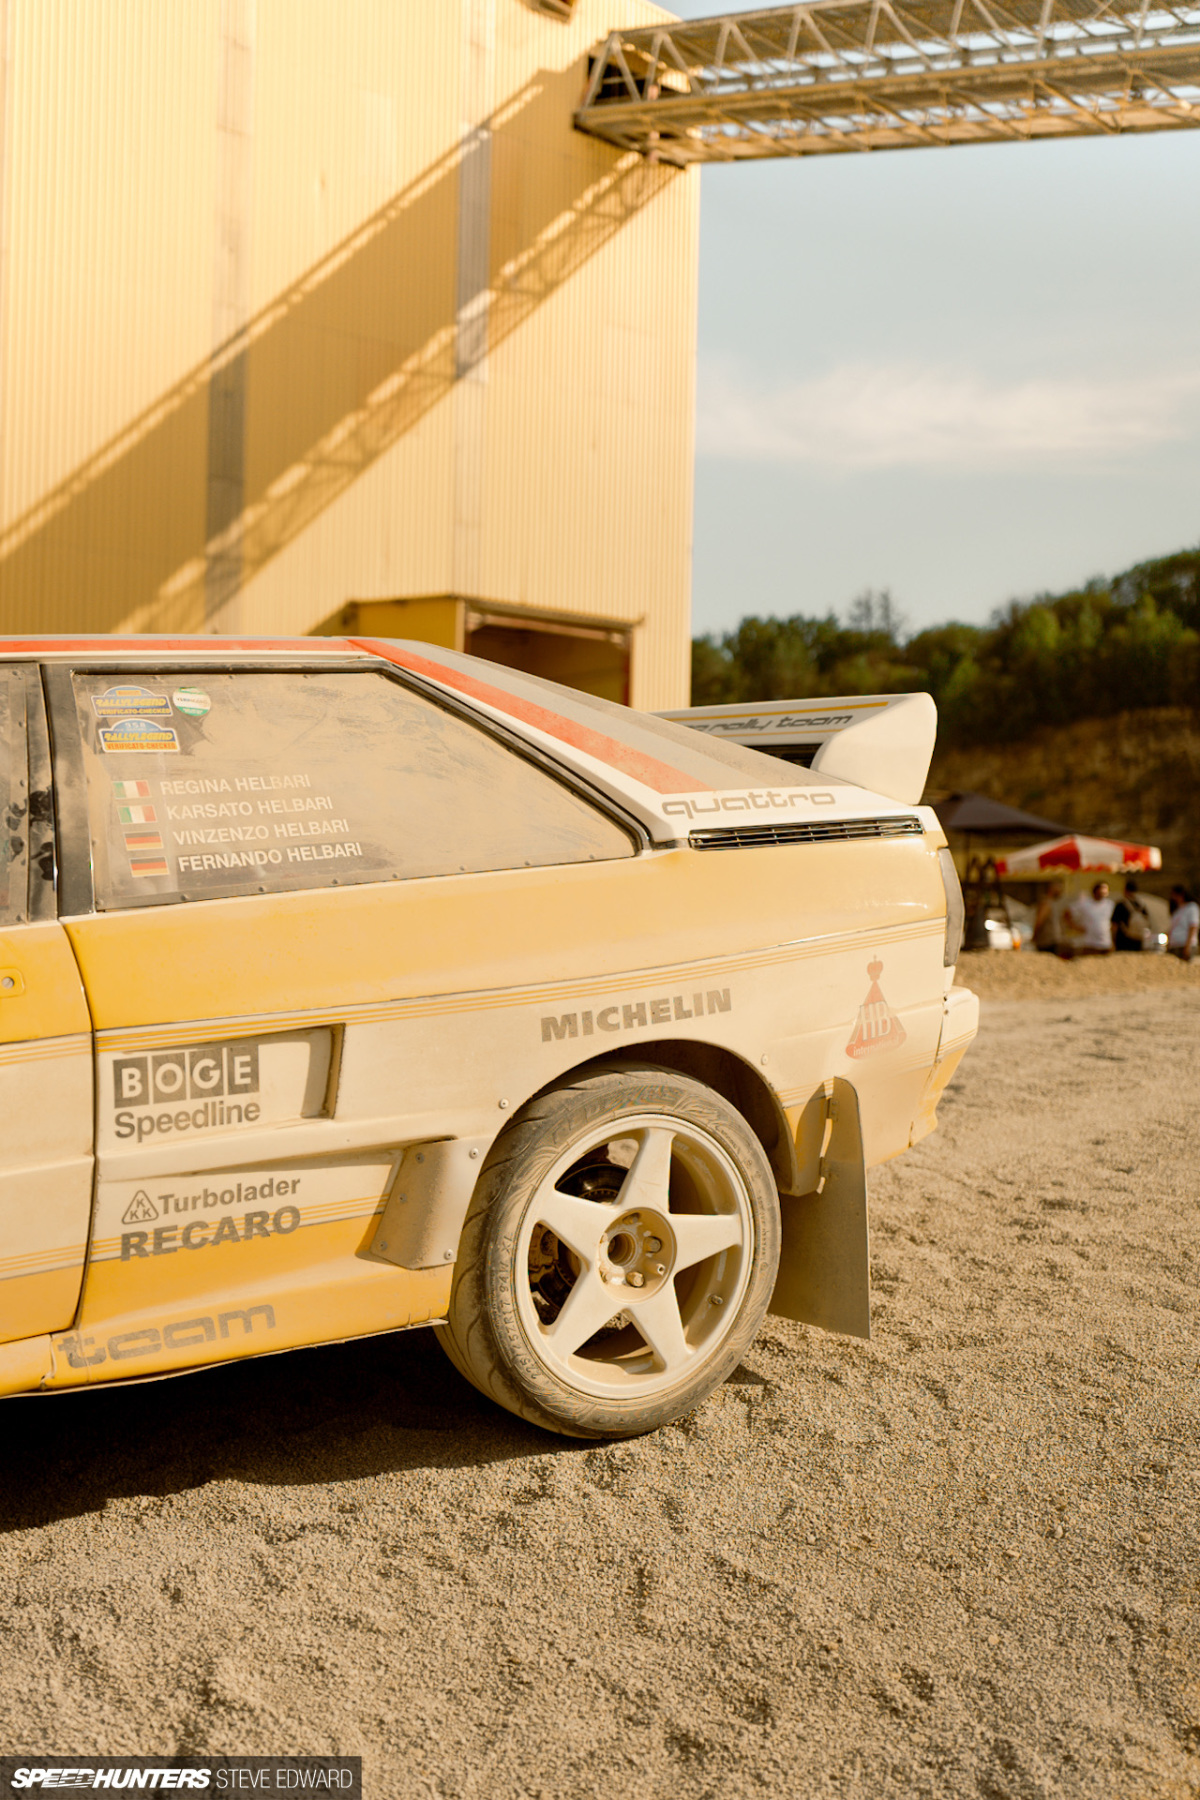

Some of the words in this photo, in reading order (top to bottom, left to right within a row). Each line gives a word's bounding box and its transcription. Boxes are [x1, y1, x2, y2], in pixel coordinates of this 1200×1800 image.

[708, 718, 773, 731] rally
[160, 778, 232, 795] REGINA
[234, 774, 311, 791] HELBARI
[166, 801, 253, 820] KARSATO
[257, 796, 333, 814] HELBARI
[662, 791, 836, 819] quattro
[173, 825, 269, 845] VINZENZO
[274, 819, 350, 838] HELBARI
[178, 849, 282, 872] FERNANDO
[287, 842, 362, 862] HELBARI
[540, 988, 732, 1042] MICHELIN
[120, 1054, 252, 1099] BOGE
[114, 1100, 260, 1143] Speedline
[158, 1178, 300, 1215] Turbolader
[120, 1205, 301, 1262] RECARO
[57, 1304, 276, 1369] team
